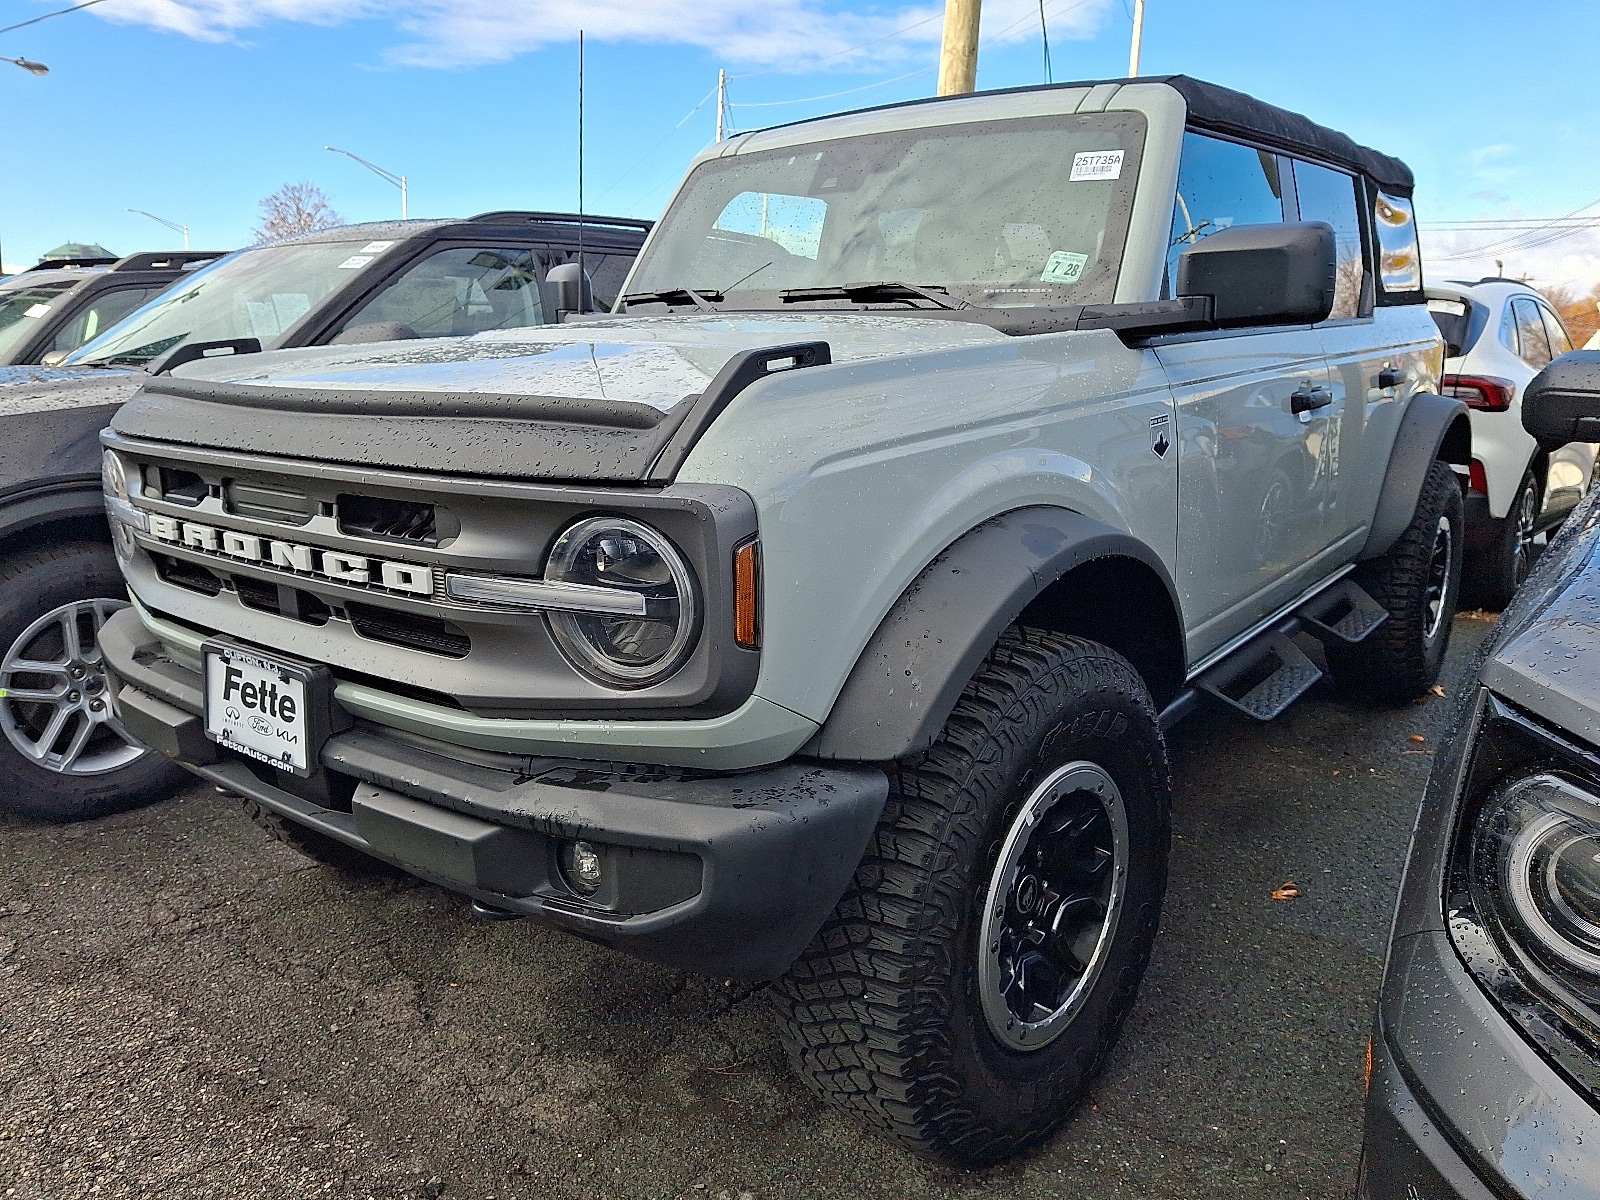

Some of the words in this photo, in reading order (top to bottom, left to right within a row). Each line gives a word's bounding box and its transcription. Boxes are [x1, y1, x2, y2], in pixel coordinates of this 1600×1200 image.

[1075, 155, 1121, 166] 25T735A
[1052, 260, 1062, 273] 7
[1063, 263, 1080, 277] 28
[149, 514, 434, 596] BRONCO
[223, 665, 297, 724] Fette
[252, 717, 270, 734] Ford
[276, 727, 298, 745] KIA
